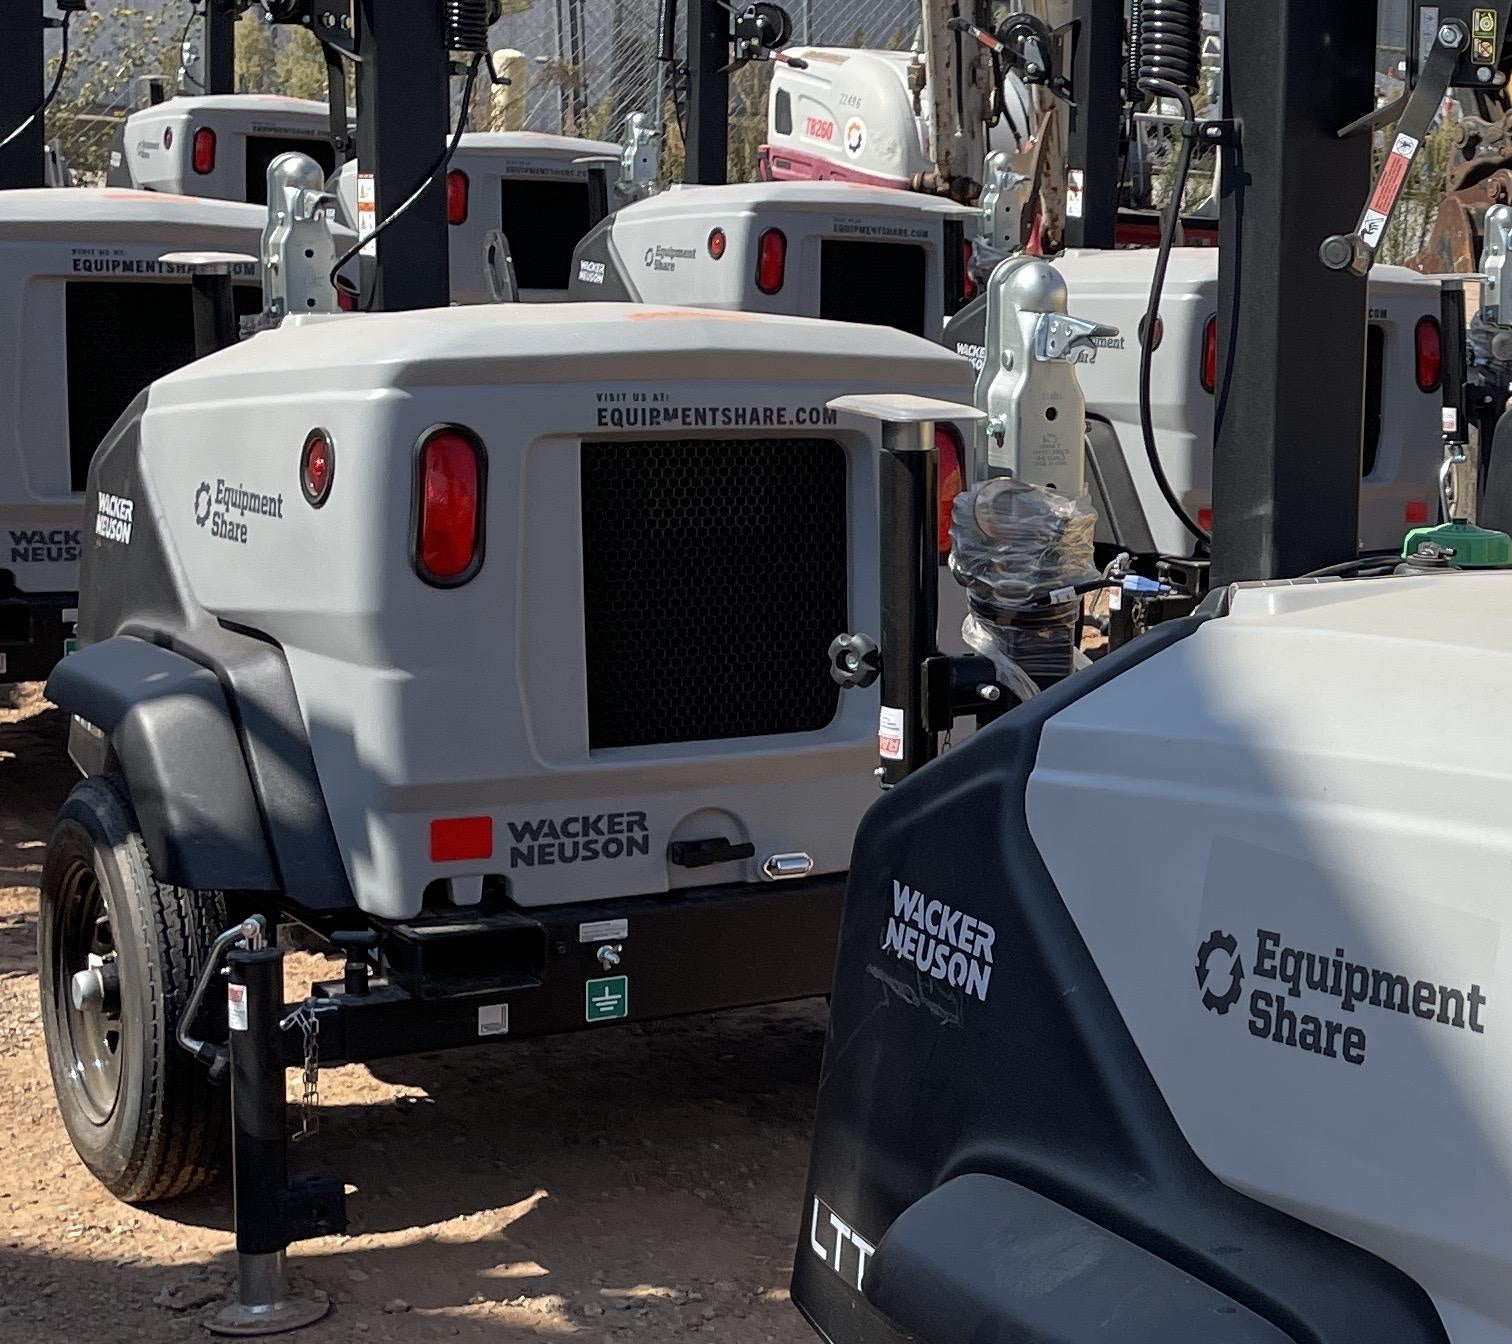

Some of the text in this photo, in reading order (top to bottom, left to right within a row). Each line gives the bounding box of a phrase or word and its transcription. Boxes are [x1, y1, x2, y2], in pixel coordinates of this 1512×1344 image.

[654, 259, 675, 271] Share
[655, 245, 696, 259] Equipment
[596, 392, 627, 402] VISIT
[632, 392, 647, 402] US
[597, 407, 837, 427] EQUIPMENTSHARE.COM
[98, 491, 134, 522] WACKER
[214, 479, 283, 519] Equipment
[95, 515, 132, 545] NEUSON
[211, 511, 248, 544] Share
[507, 811, 649, 843] WACKER
[510, 834, 649, 868] NEUSON
[893, 879, 996, 964] WACKER
[881, 917, 992, 1002] NEUSON
[1253, 928, 1486, 1034] Equipment
[1248, 988, 1366, 1065] Share
